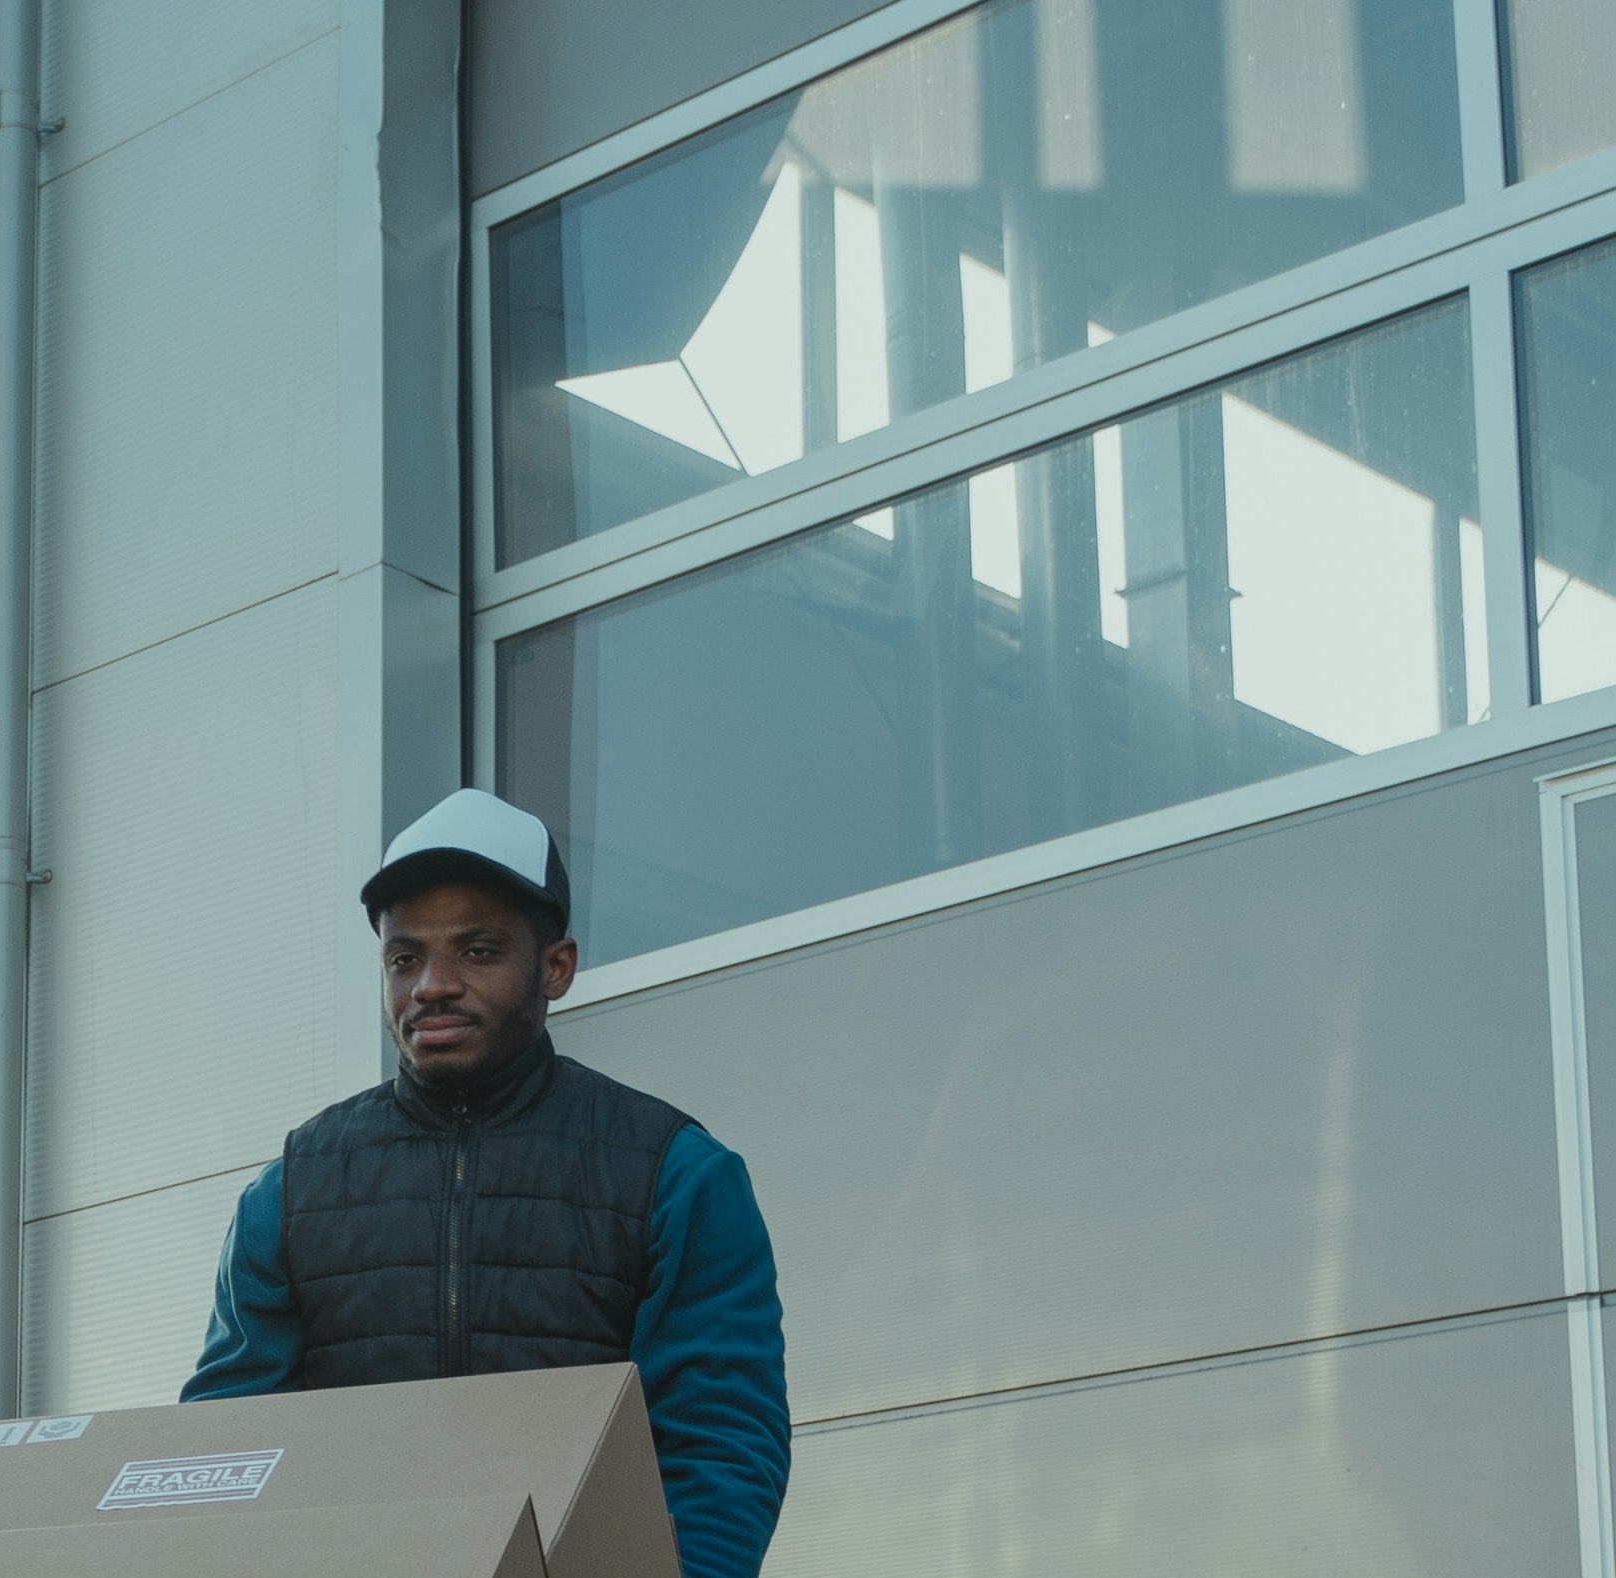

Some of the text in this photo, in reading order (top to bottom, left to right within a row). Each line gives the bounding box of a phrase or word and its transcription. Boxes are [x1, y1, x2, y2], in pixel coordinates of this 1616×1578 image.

[113, 1477, 259, 1495] HANDLE WITH CARE
[117, 1465, 266, 1489] FRAGILE
